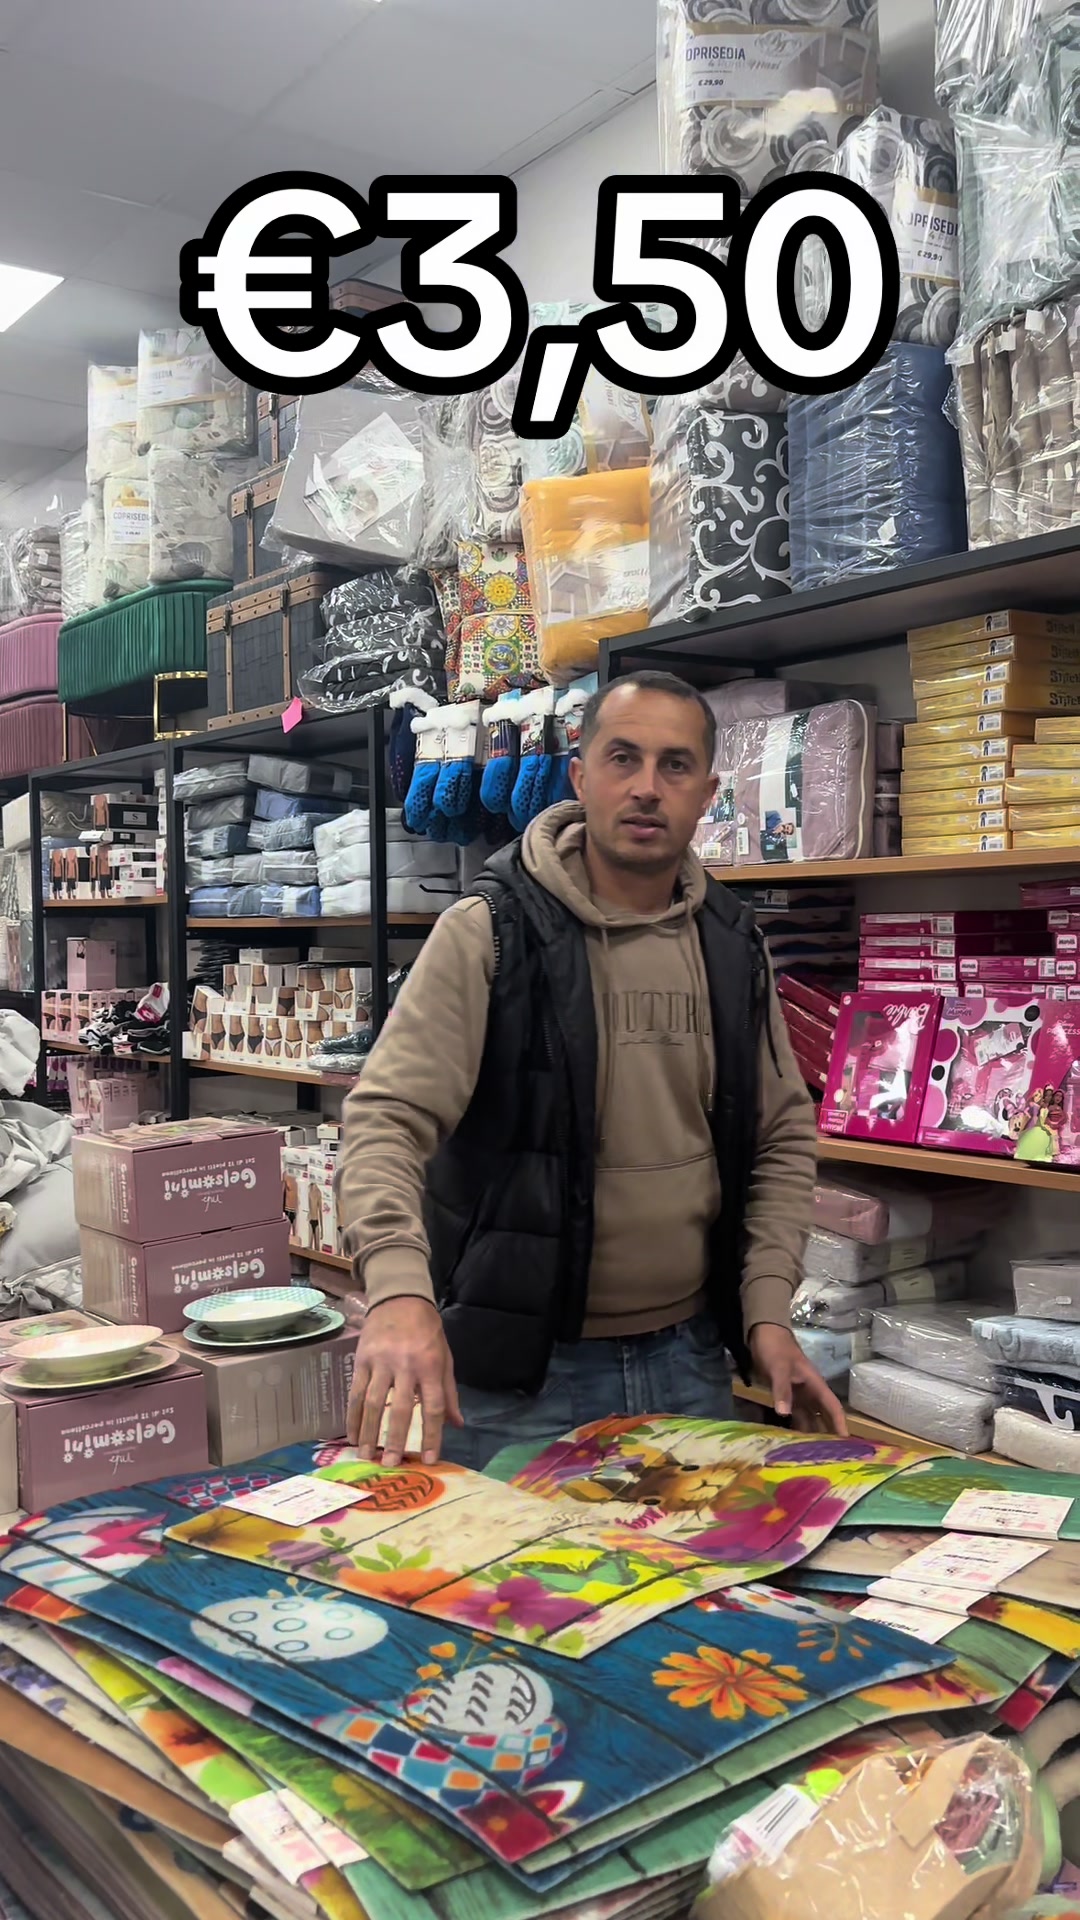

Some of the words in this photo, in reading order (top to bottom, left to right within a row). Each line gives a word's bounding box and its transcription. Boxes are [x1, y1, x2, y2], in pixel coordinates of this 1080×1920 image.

[881, 1002, 931, 1031] Barbie
[163, 1167, 257, 1201] Gelsomini
[173, 1257, 265, 1294] Gelsomini
[62, 1418, 176, 1464] Gelsomini
